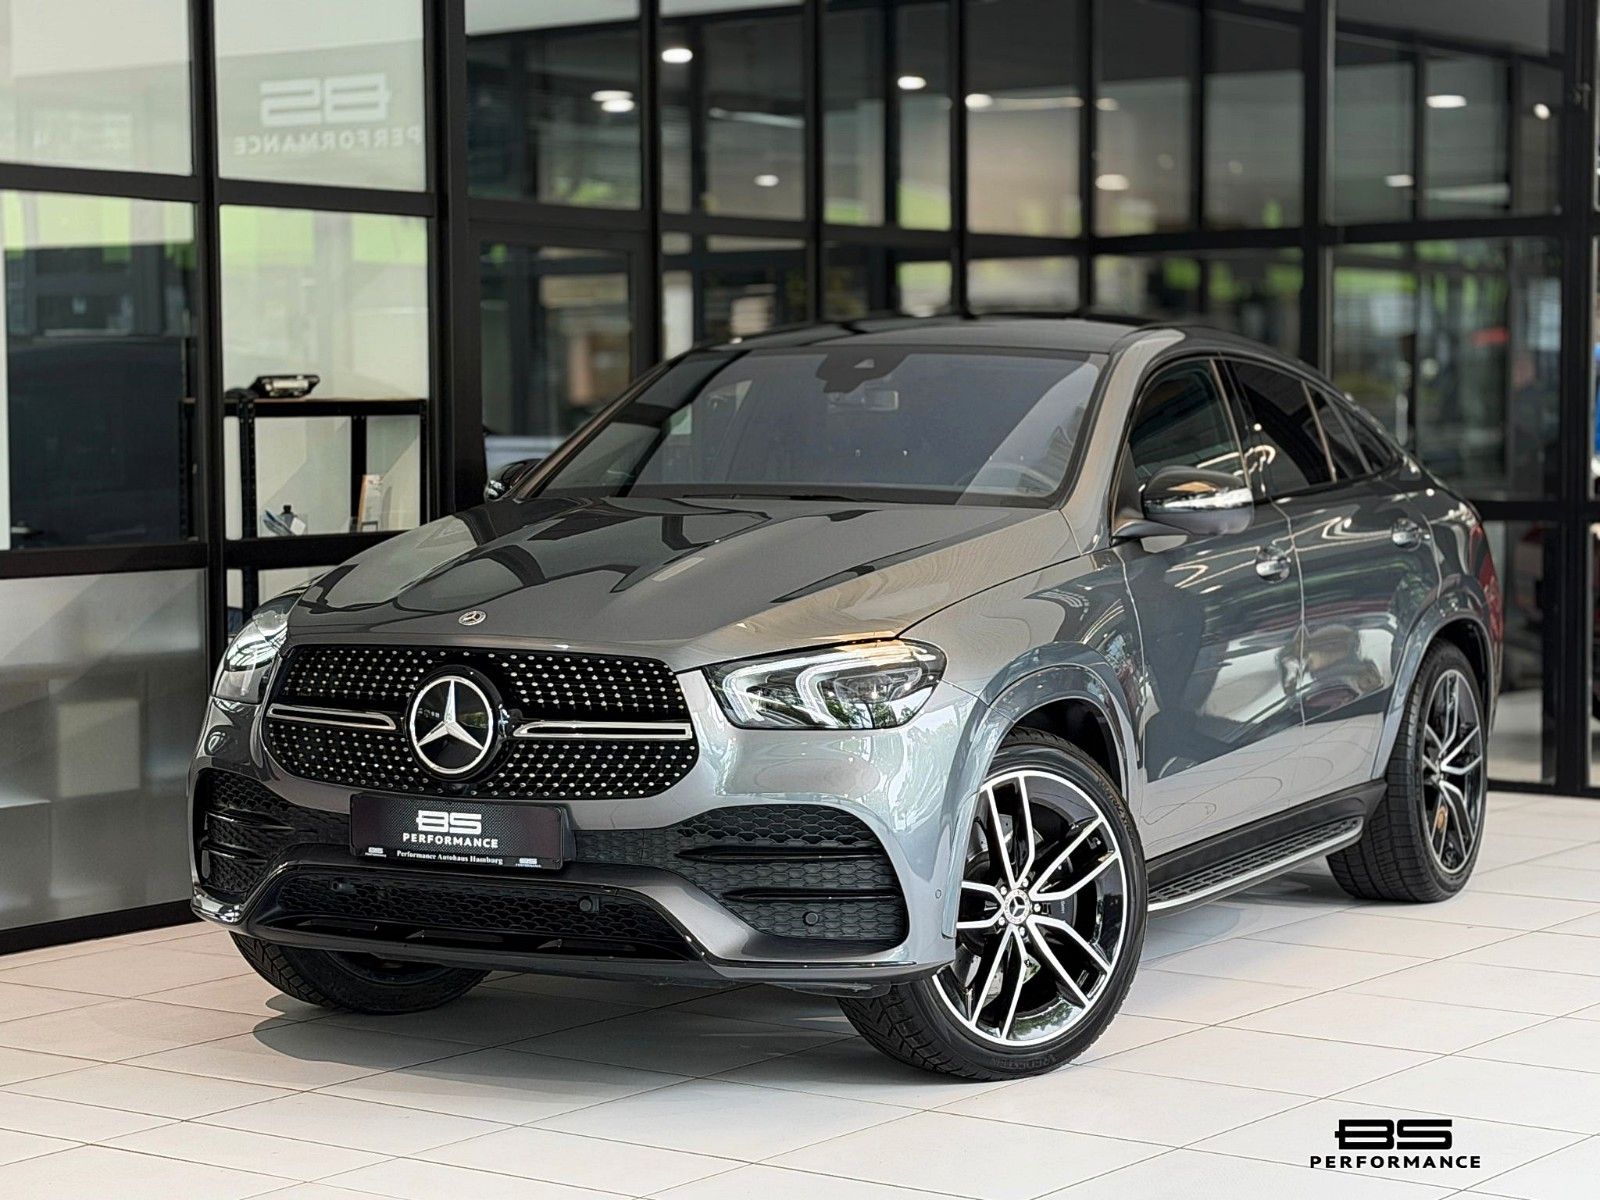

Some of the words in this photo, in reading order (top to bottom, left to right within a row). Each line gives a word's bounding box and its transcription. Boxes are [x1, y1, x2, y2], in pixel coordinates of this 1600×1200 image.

[416, 809, 482, 835] BS
[402, 832, 499, 849] PERFORMANCE
[396, 850, 437, 860] Performance
[437, 854, 469, 862] Autohaus
[469, 855, 503, 865] Hamburg
